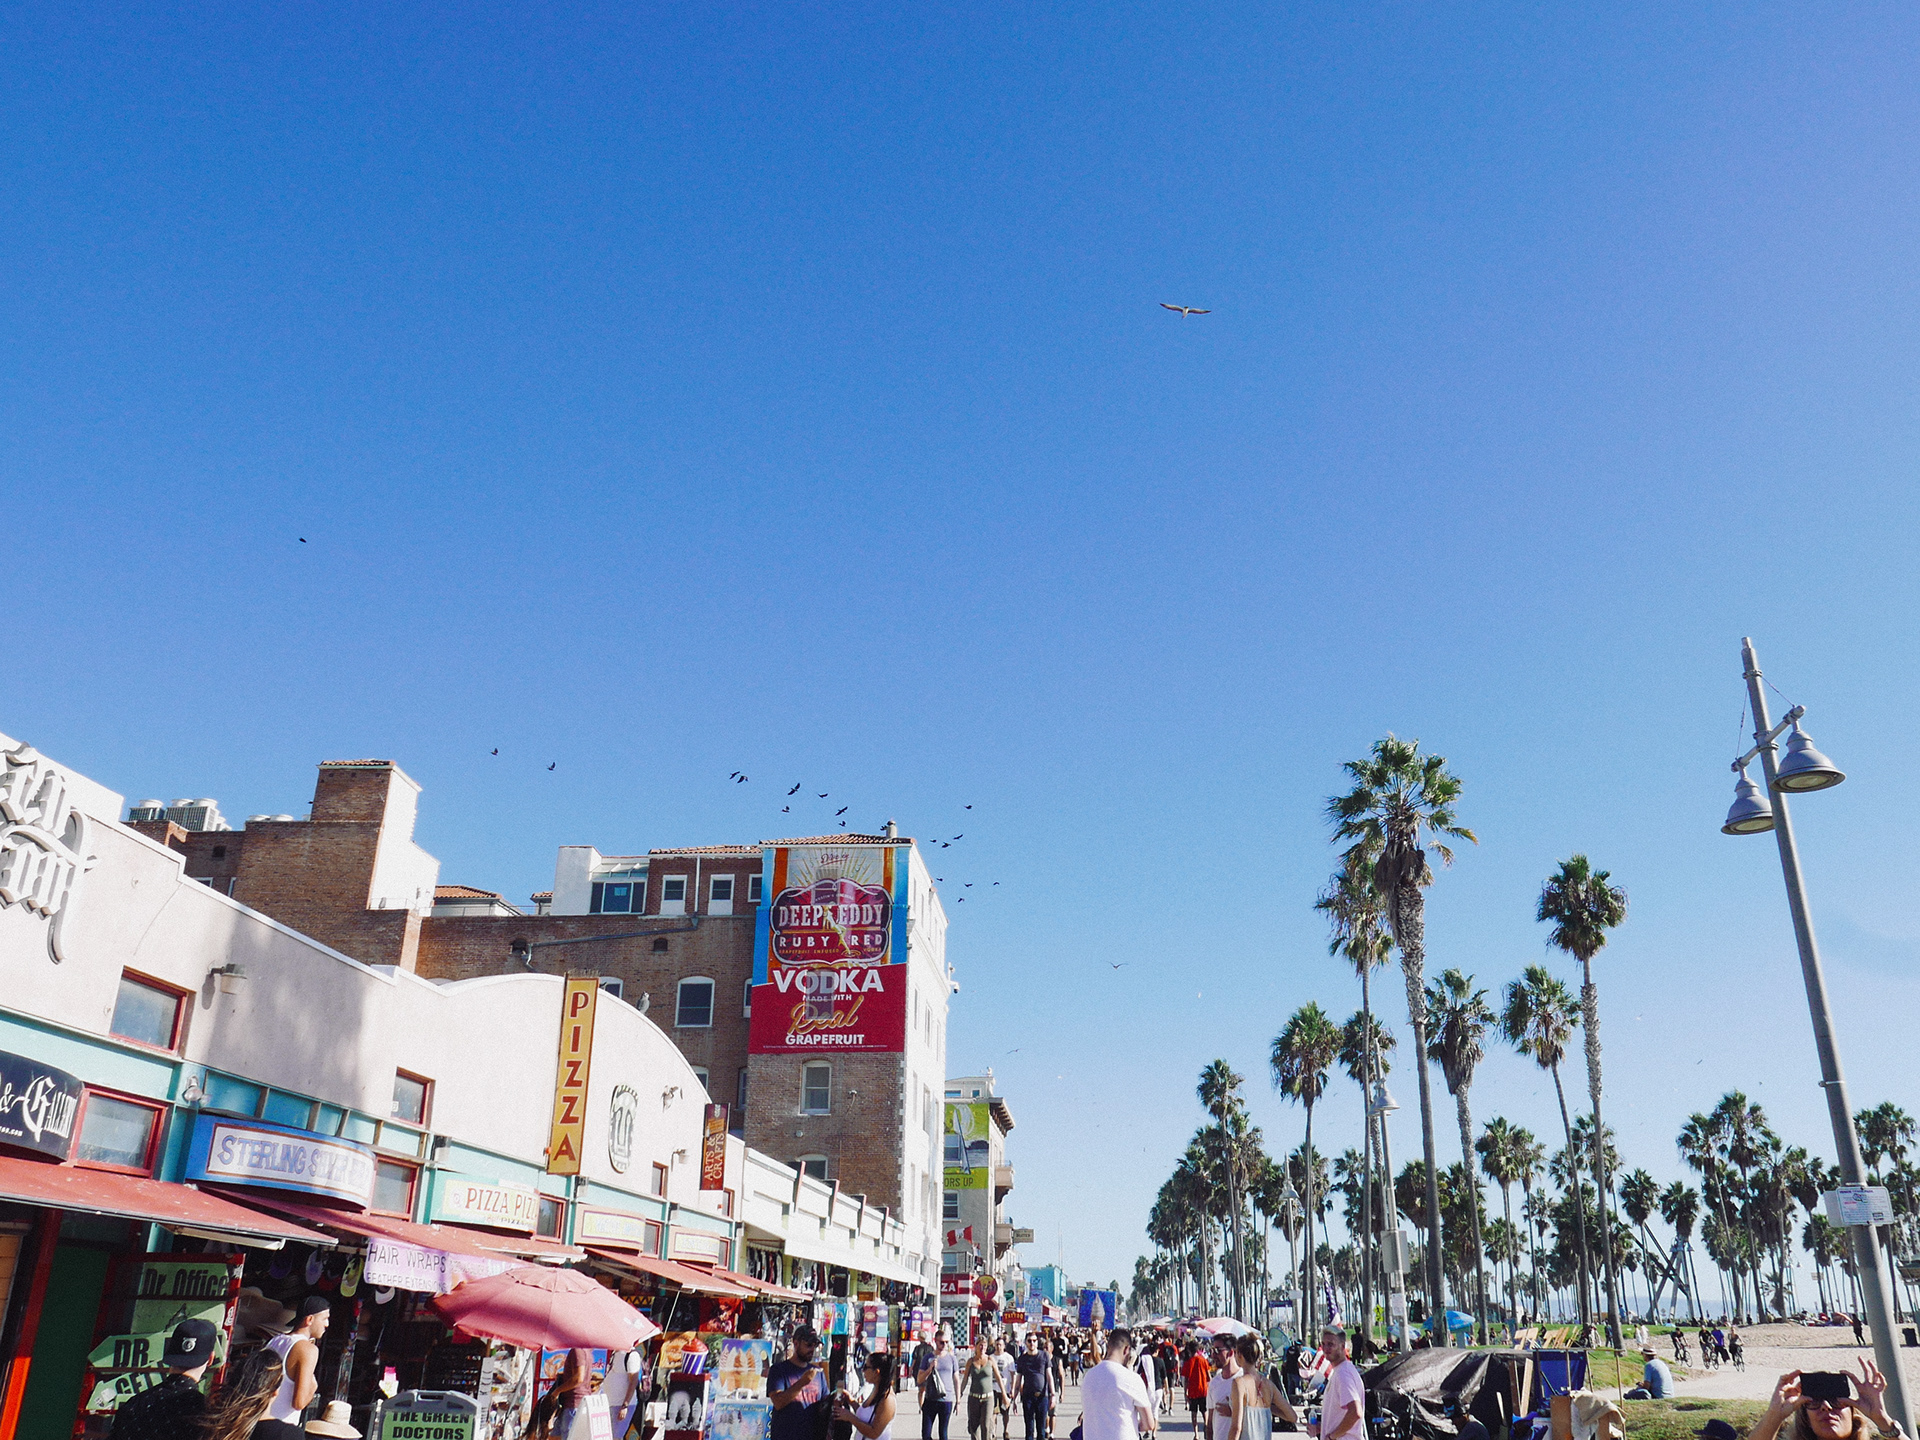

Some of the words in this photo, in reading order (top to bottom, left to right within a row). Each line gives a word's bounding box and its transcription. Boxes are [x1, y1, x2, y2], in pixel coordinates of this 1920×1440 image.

[779, 905, 823, 926] DEEP
[839, 904, 883, 925] EDDY
[780, 936, 830, 947] RUBY
[851, 934, 882, 945] RED
[772, 969, 885, 993] VODKA
[802, 994, 829, 1003] MADE
[787, 994, 864, 1035] Real
[785, 1034, 865, 1045] GRAPEFRUIT
[553, 991, 589, 1162] PIZZA
[706, 1136, 716, 1147] &
[217, 1134, 306, 1175] STERLING
[704, 1150, 715, 1181] ARTS
[713, 1132, 725, 1179] CRAFTS
[963, 1177, 974, 1187] UP
[465, 1187, 509, 1214] PIZZA
[367, 1243, 399, 1265] HAIR
[406, 1250, 447, 1274] WRAPS
[172, 1268, 229, 1297] Office
[366, 1271, 402, 1286] FEATHER
[405, 1276, 448, 1294] EXTENSIONS
[941, 1282, 956, 1292] ZA
[392, 1412, 418, 1422] THE
[422, 1412, 469, 1424] GREEN
[392, 1426, 464, 1440] DOCTORS
